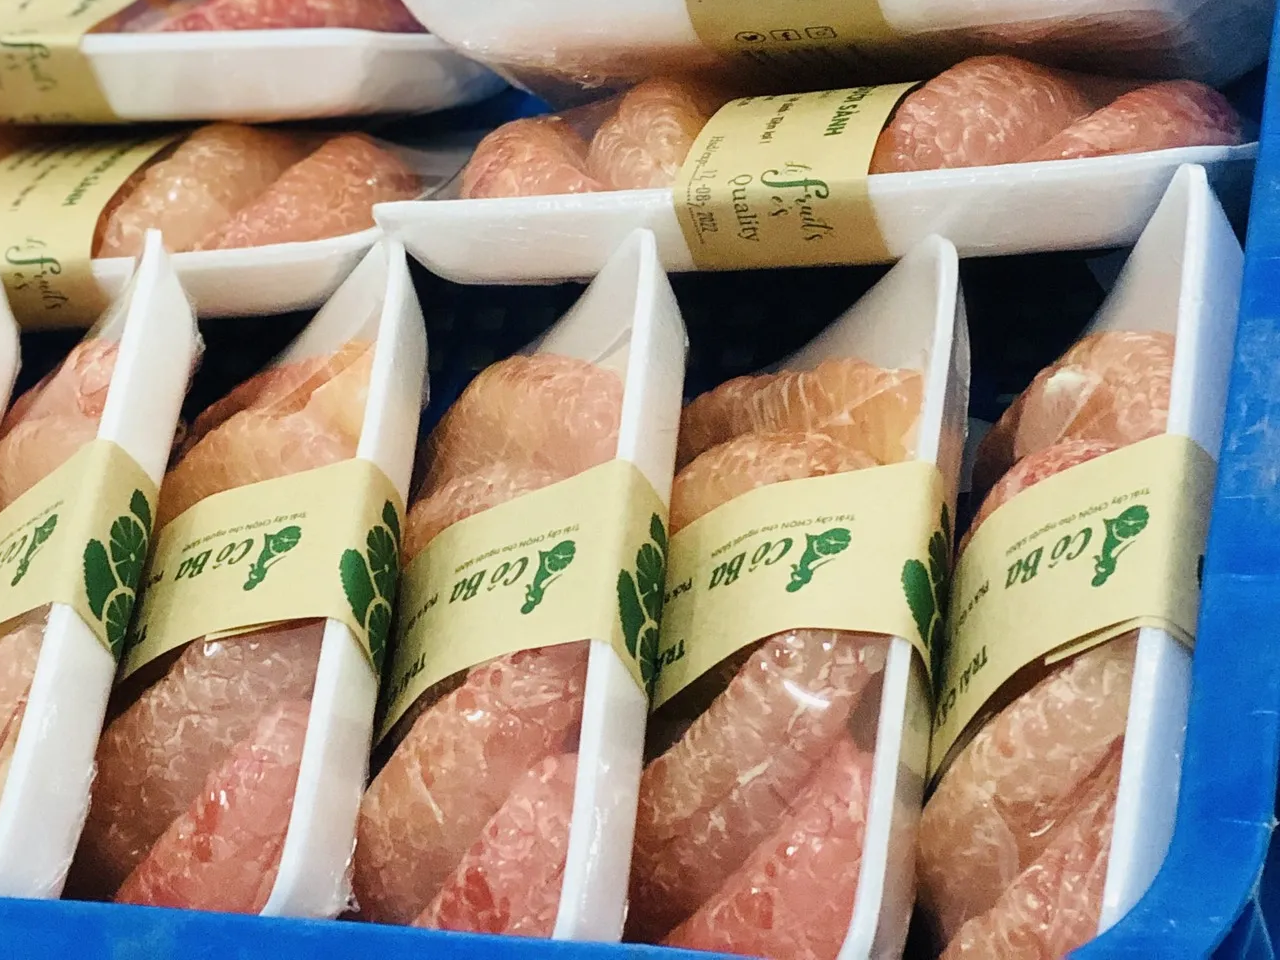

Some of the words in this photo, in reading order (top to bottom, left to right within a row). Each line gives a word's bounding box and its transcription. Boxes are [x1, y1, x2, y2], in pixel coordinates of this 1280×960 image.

[824, 104, 861, 136] SÀNH
[728, 174, 760, 242] Quality
[174, 549, 213, 582] Ba
[212, 538, 255, 570] Cô
[748, 537, 793, 572] Cô
[1048, 527, 1093, 569] Cô
[486, 556, 529, 592] Cô
[708, 551, 747, 591] Ba
[1004, 546, 1044, 590] Ba
[448, 569, 487, 605] Ba
[959, 645, 987, 694] TRÁI
